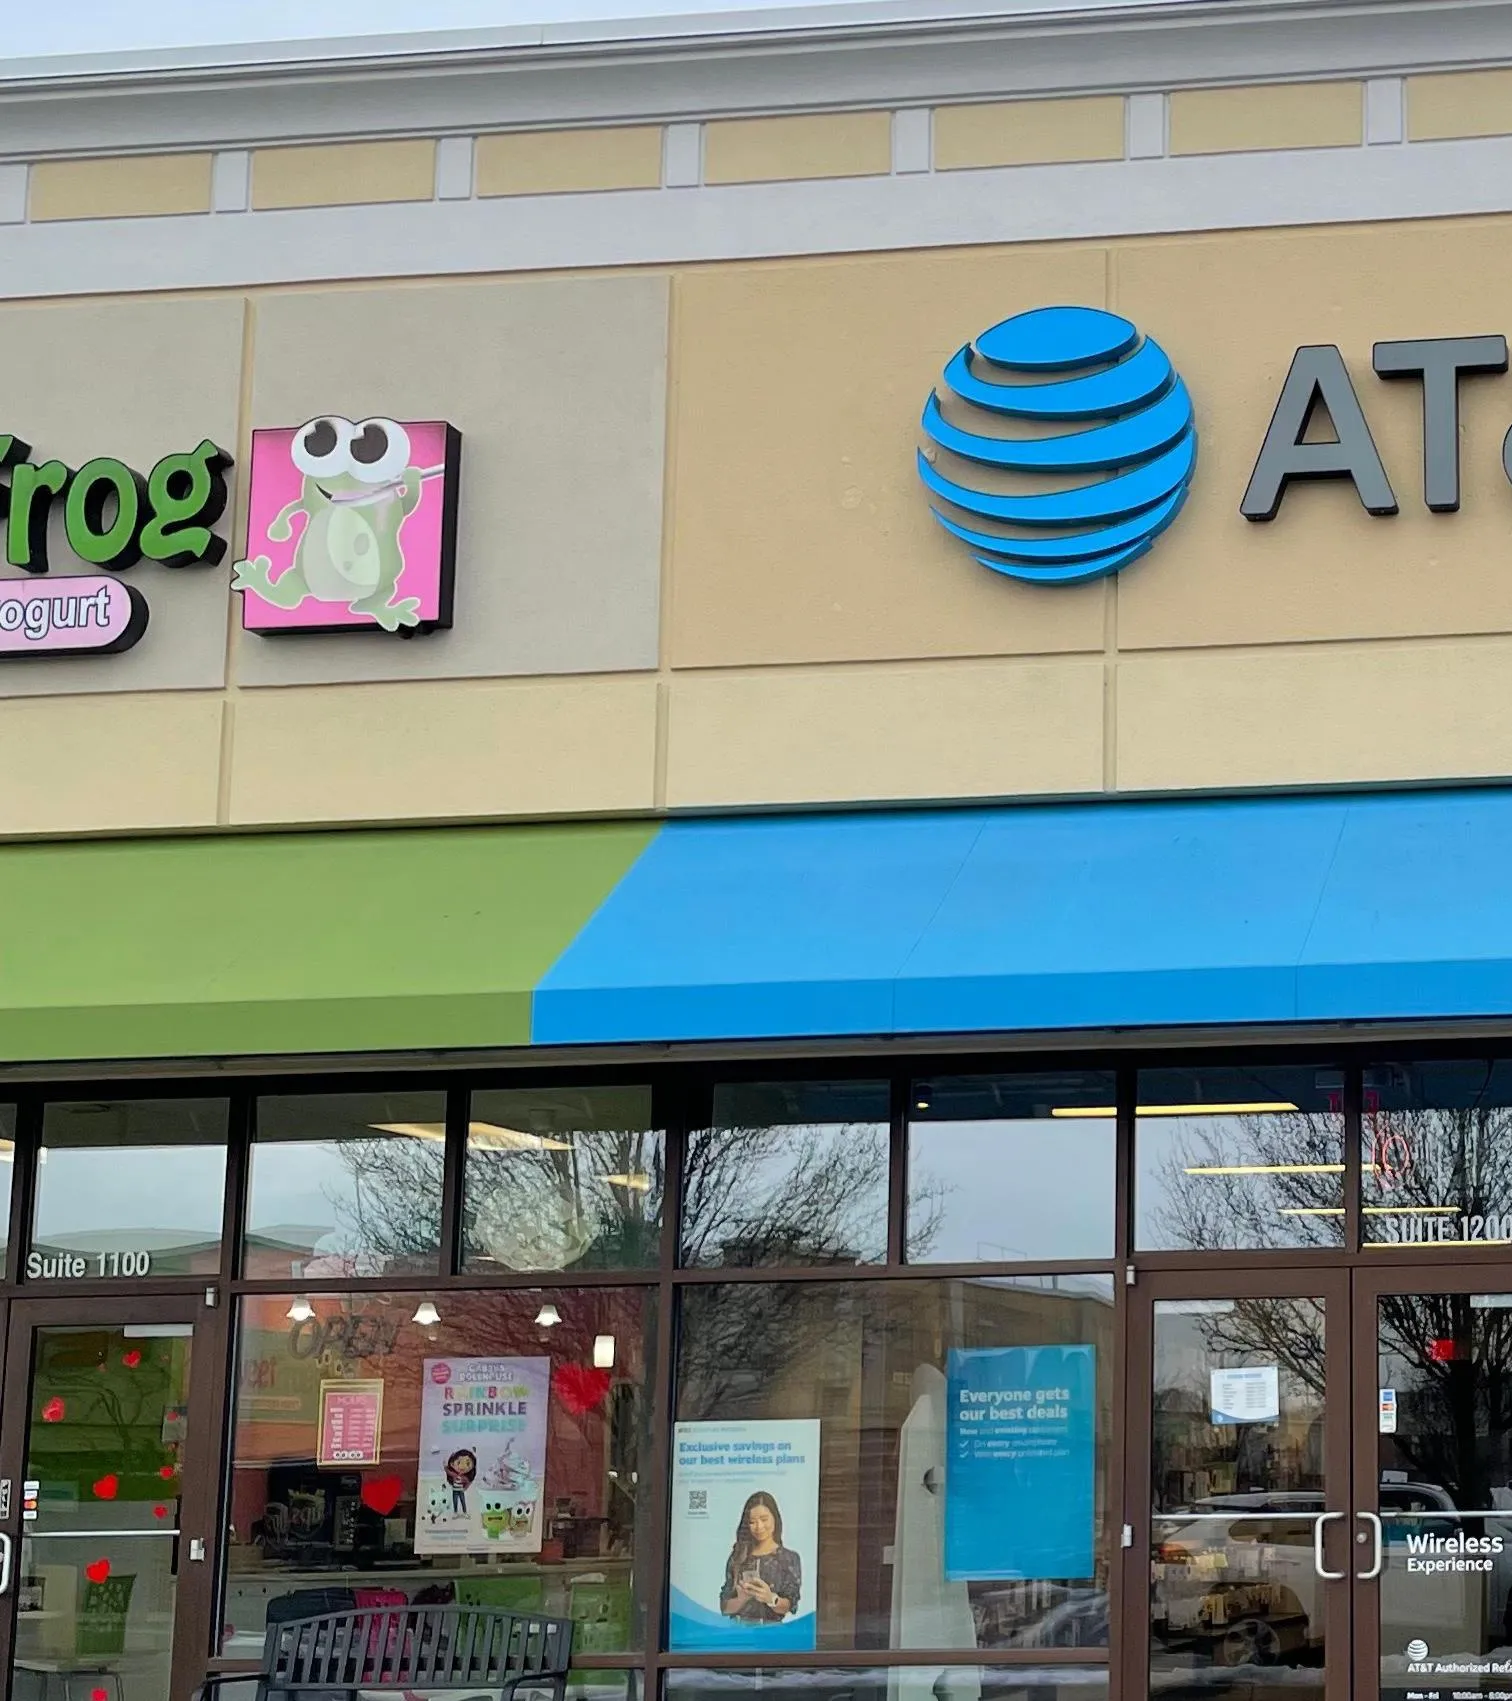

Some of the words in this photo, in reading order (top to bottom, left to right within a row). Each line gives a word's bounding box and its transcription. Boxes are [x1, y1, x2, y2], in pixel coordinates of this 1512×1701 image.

[0, 584, 111, 640] ogurt
[1385, 1216, 1450, 1243] SUITE
[26, 1252, 86, 1278] Suite
[97, 1251, 150, 1277] 1100
[960, 1389, 1032, 1405] Everyone
[1035, 1387, 1069, 1404] gets
[443, 1401, 528, 1416] SPRINKLE
[960, 1409, 986, 1421] our
[989, 1406, 1024, 1420] best
[1027, 1404, 1068, 1420] deals
[679, 1442, 731, 1452] Exclusive
[733, 1441, 776, 1453] savings
[679, 1456, 697, 1465] our
[700, 1455, 725, 1465] best
[728, 1454, 773, 1464] wireless
[776, 1455, 805, 1466] plans
[1406, 1531, 1504, 1554] Wireless
[1407, 1557, 1494, 1575] Experience
[1407, 1663, 1434, 1673] AT&T
[1435, 1662, 1491, 1673] Authorized
